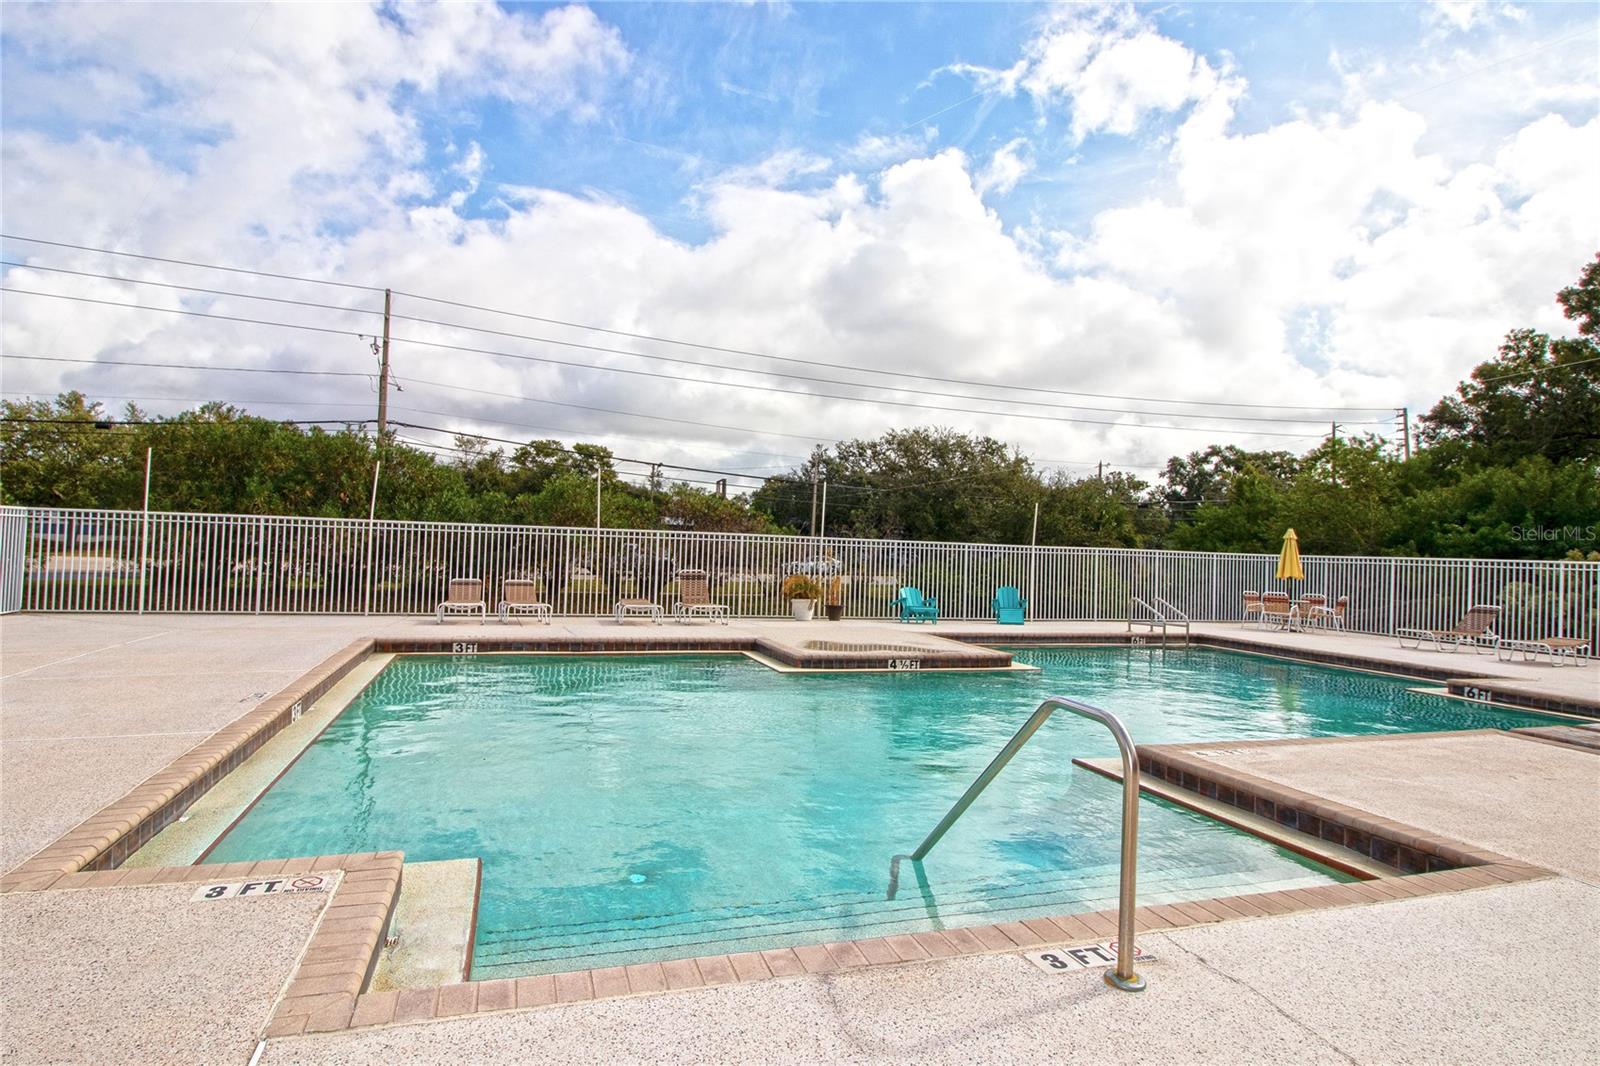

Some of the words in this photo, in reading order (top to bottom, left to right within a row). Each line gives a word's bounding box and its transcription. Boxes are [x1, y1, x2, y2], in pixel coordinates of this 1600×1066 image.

[455, 643, 464, 653] 3
[466, 643, 476, 653] FT
[890, 660, 897, 669] 4
[910, 660, 918, 669] FT
[1467, 687, 1475, 698] 6
[204, 886, 228, 898] 3
[1040, 954, 1068, 969] 3
